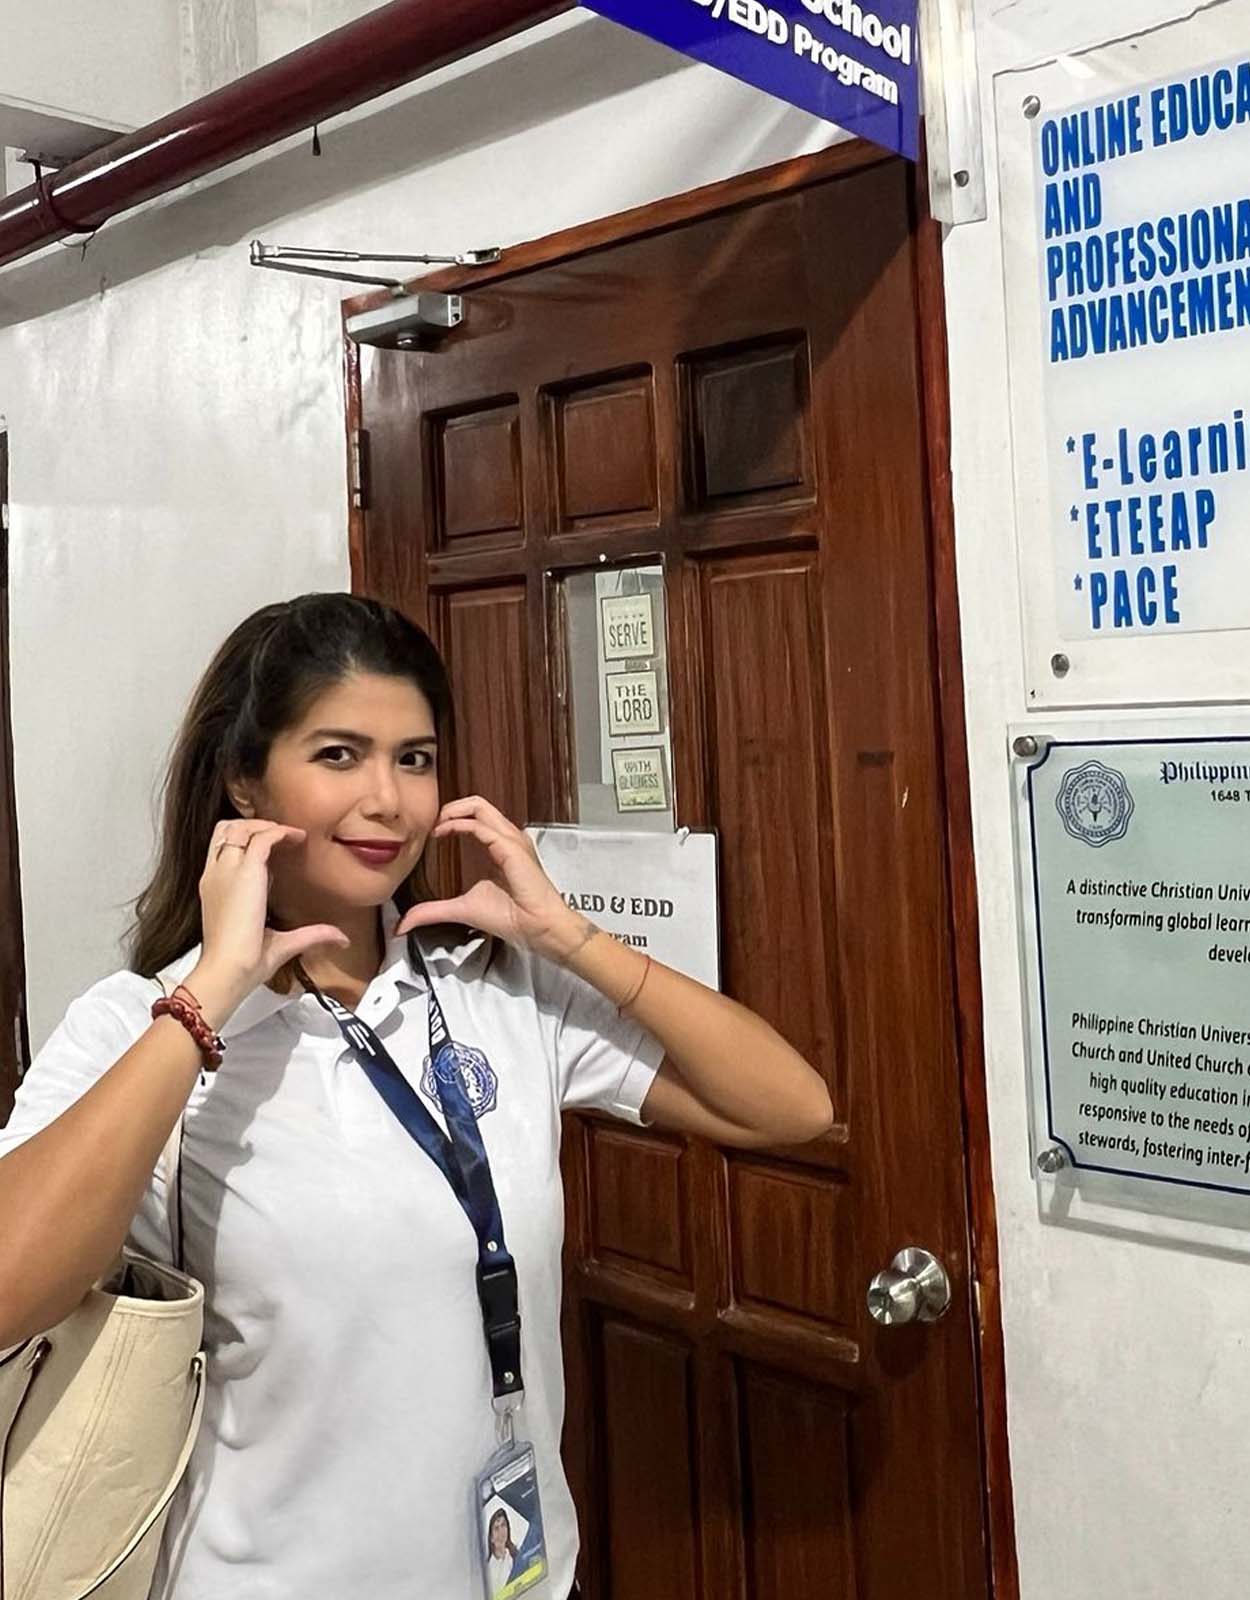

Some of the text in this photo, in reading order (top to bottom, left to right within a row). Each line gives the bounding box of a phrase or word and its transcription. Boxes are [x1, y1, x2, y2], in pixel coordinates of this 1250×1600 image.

[692, 0, 898, 105] /EDD Program
[1041, 61, 1250, 177] ONLINE EDUCA
[1044, 172, 1101, 239] AND
[1046, 198, 1250, 302] PROFESSIONA
[609, 621, 647, 648] SERVE
[615, 684, 647, 698] THE
[614, 697, 652, 722] LORD
[1211, 790, 1240, 802] 1648
[1066, 879, 1076, 895] A
[1079, 878, 1148, 898] distinctive
[1151, 881, 1213, 900] Christian
[610, 896, 625, 914] &
[630, 897, 674, 918] EDD
[1076, 908, 1163, 932] transforming
[1167, 912, 1212, 932] global
[1071, 1012, 1134, 1034] Philippine
[1138, 1018, 1196, 1040] Christian
[1072, 1041, 1115, 1061] Church
[1118, 1048, 1143, 1064] and
[1147, 1049, 1191, 1070] United
[1195, 1054, 1243, 1076] Church
[1089, 1072, 1117, 1093] high
[1121, 1077, 1167, 1100] quality
[1170, 1082, 1238, 1106] education
[1079, 1103, 1147, 1124] responsive
[1151, 1111, 1164, 1126] to
[1168, 1112, 1190, 1130] the
[1193, 1117, 1234, 1136] needs
[1078, 1131, 1140, 1156] stewards,
[1142, 1137, 1203, 1166] fostering
